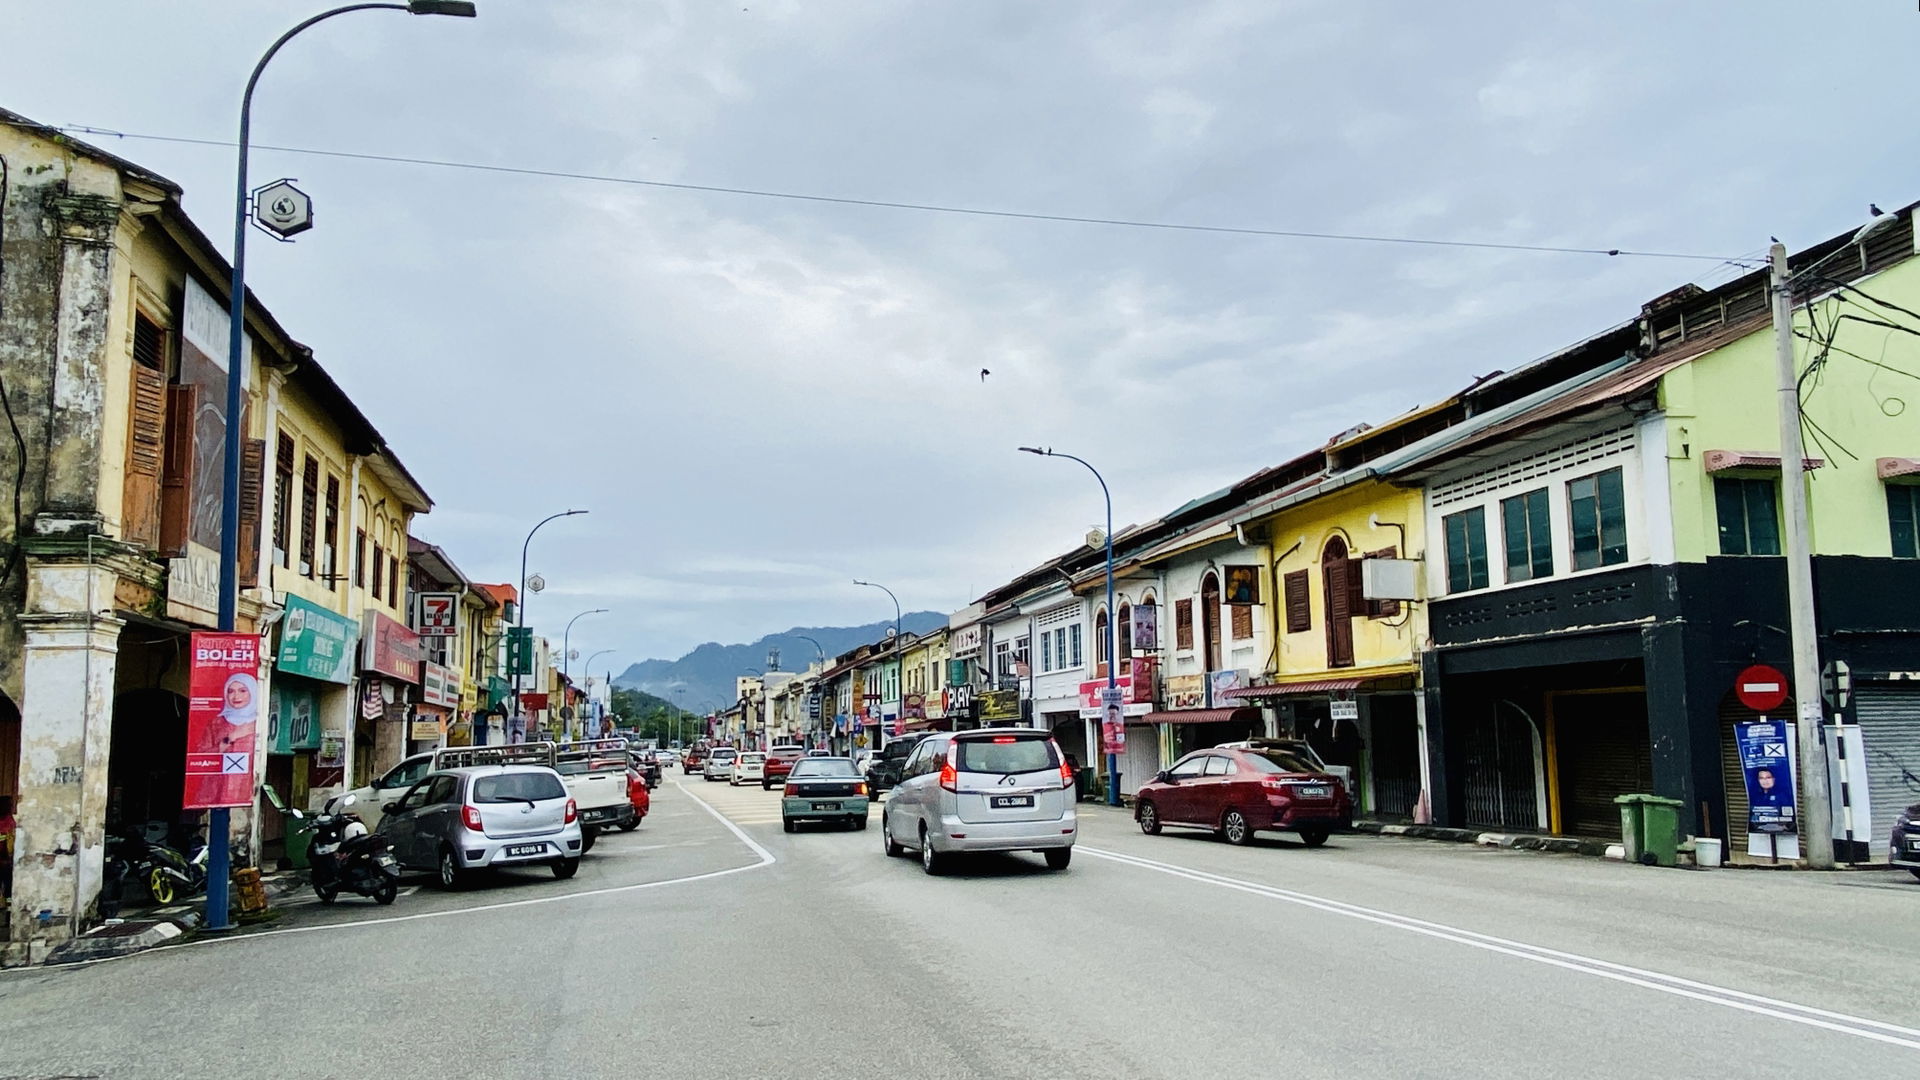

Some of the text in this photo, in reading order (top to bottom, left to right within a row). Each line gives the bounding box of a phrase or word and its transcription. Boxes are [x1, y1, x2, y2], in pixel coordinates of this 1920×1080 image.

[197, 637, 234, 649] KITA
[196, 649, 255, 661] BOLEH
[948, 686, 971, 709] PLAY
